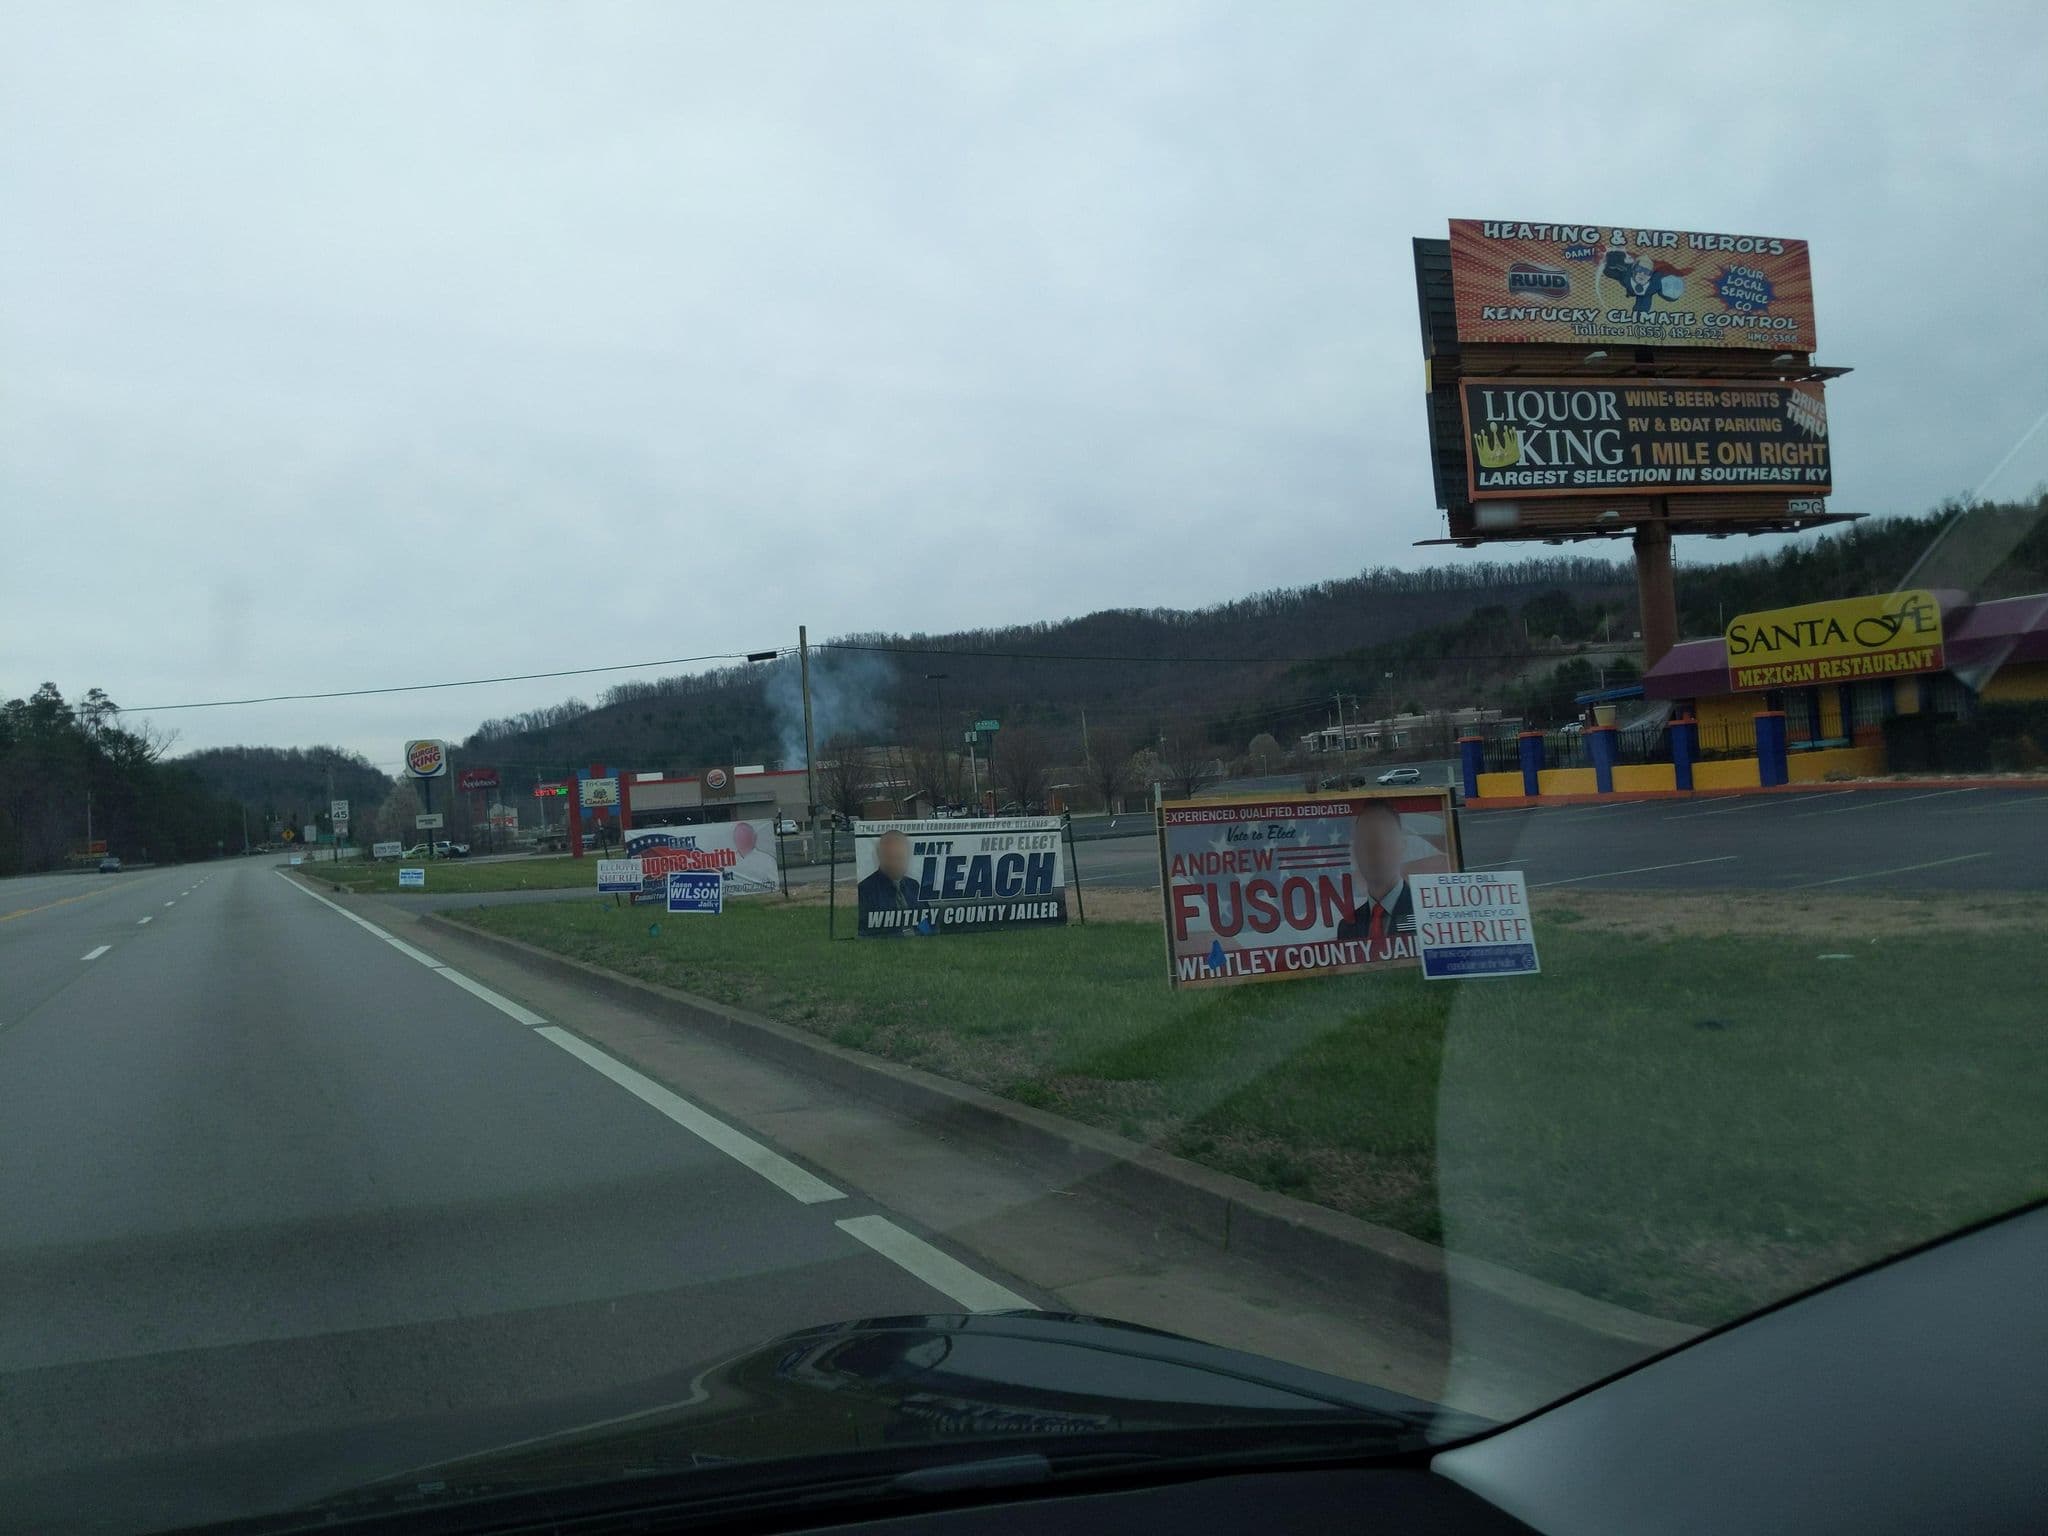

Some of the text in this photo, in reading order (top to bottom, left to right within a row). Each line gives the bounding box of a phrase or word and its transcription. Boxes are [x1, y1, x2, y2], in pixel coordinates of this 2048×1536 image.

[1482, 221, 1785, 256] HEATING & AIR HEROES
[1510, 272, 1568, 289] RUUD
[1730, 264, 1765, 279] YOUR
[1727, 276, 1764, 291] LOCAL
[1721, 287, 1768, 304] SERVICE
[1735, 301, 1752, 312] CO
[1482, 306, 1799, 330] KENTUCKY CLIMATE CONTROL
[1483, 391, 1621, 427] LIQUOR
[1791, 388, 1826, 418] DRIVE
[1628, 418, 1783, 432] RV & BOAT PARKING
[1786, 401, 1827, 440] THRU
[1516, 430, 1624, 466] KING
[1631, 442, 1827, 465] 1 MILE ON RIGHT
[1480, 468, 1828, 486] LARGEST SELECTION IN SOUTHEAST KY
[1729, 617, 1849, 655] SANTA
[1738, 648, 1934, 688] MEXICAN RESTAURANT
[413, 752, 441, 768] KING
[333, 811, 348, 819] 45
[1165, 804, 1353, 823] EXPERIENCED. QUALIFIED. DEDICATED.
[980, 835, 1057, 850] HELP ELECT
[1226, 824, 1296, 842] Vote to Elect
[690, 848, 736, 870] Smith
[913, 841, 954, 855] MATT
[1171, 848, 1274, 877] ANDREW
[918, 852, 1057, 901] LEACH
[1438, 875, 1473, 885] ELECT
[671, 887, 720, 899] WILSON
[1420, 883, 1521, 908] ELLIOTTE
[868, 902, 1058, 928] WHITLEY COUNTY JAILER
[1172, 873, 1357, 942] FUSON
[1429, 911, 1452, 920] FOR
[1453, 910, 1497, 919] WHITLEY
[1421, 918, 1527, 946] SHERIFF
[1284, 940, 1371, 970] COUNTY
